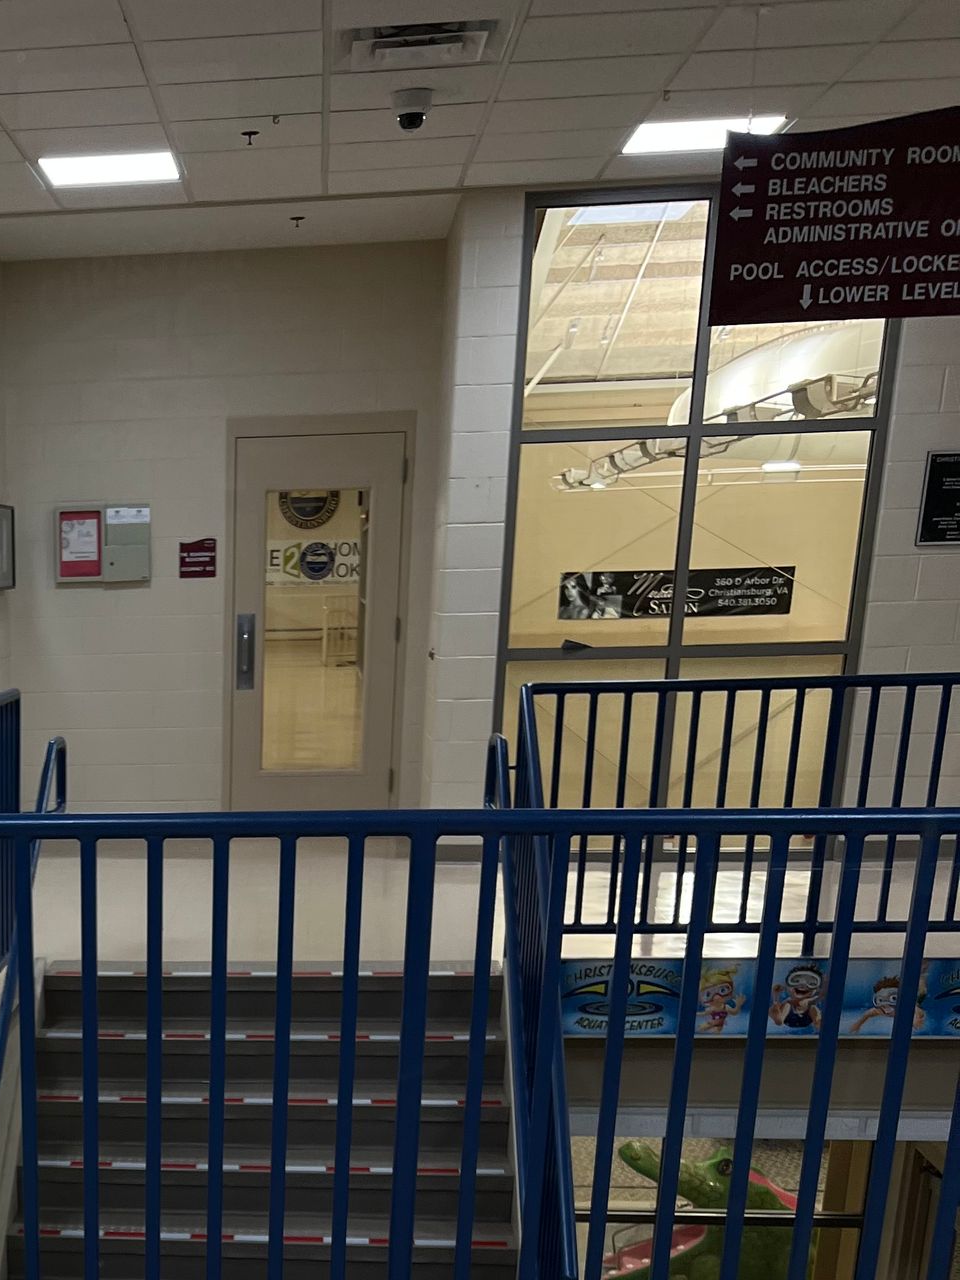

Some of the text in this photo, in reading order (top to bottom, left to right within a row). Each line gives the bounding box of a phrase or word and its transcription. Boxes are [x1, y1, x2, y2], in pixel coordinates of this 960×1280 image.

[770, 148, 895, 171] COMMUNITY
[767, 174, 887, 196] BLEACHERS
[765, 198, 894, 221] RESTROOMS
[763, 219, 960, 245] ADMINISTRATIVE O
[729, 262, 784, 281] POOL
[818, 282, 960, 304] LOWER LEVEL
[744, 576, 770, 586] Arbor
[776, 586, 789, 595] VA
[566, 963, 682, 984] CHRISTNSBURG
